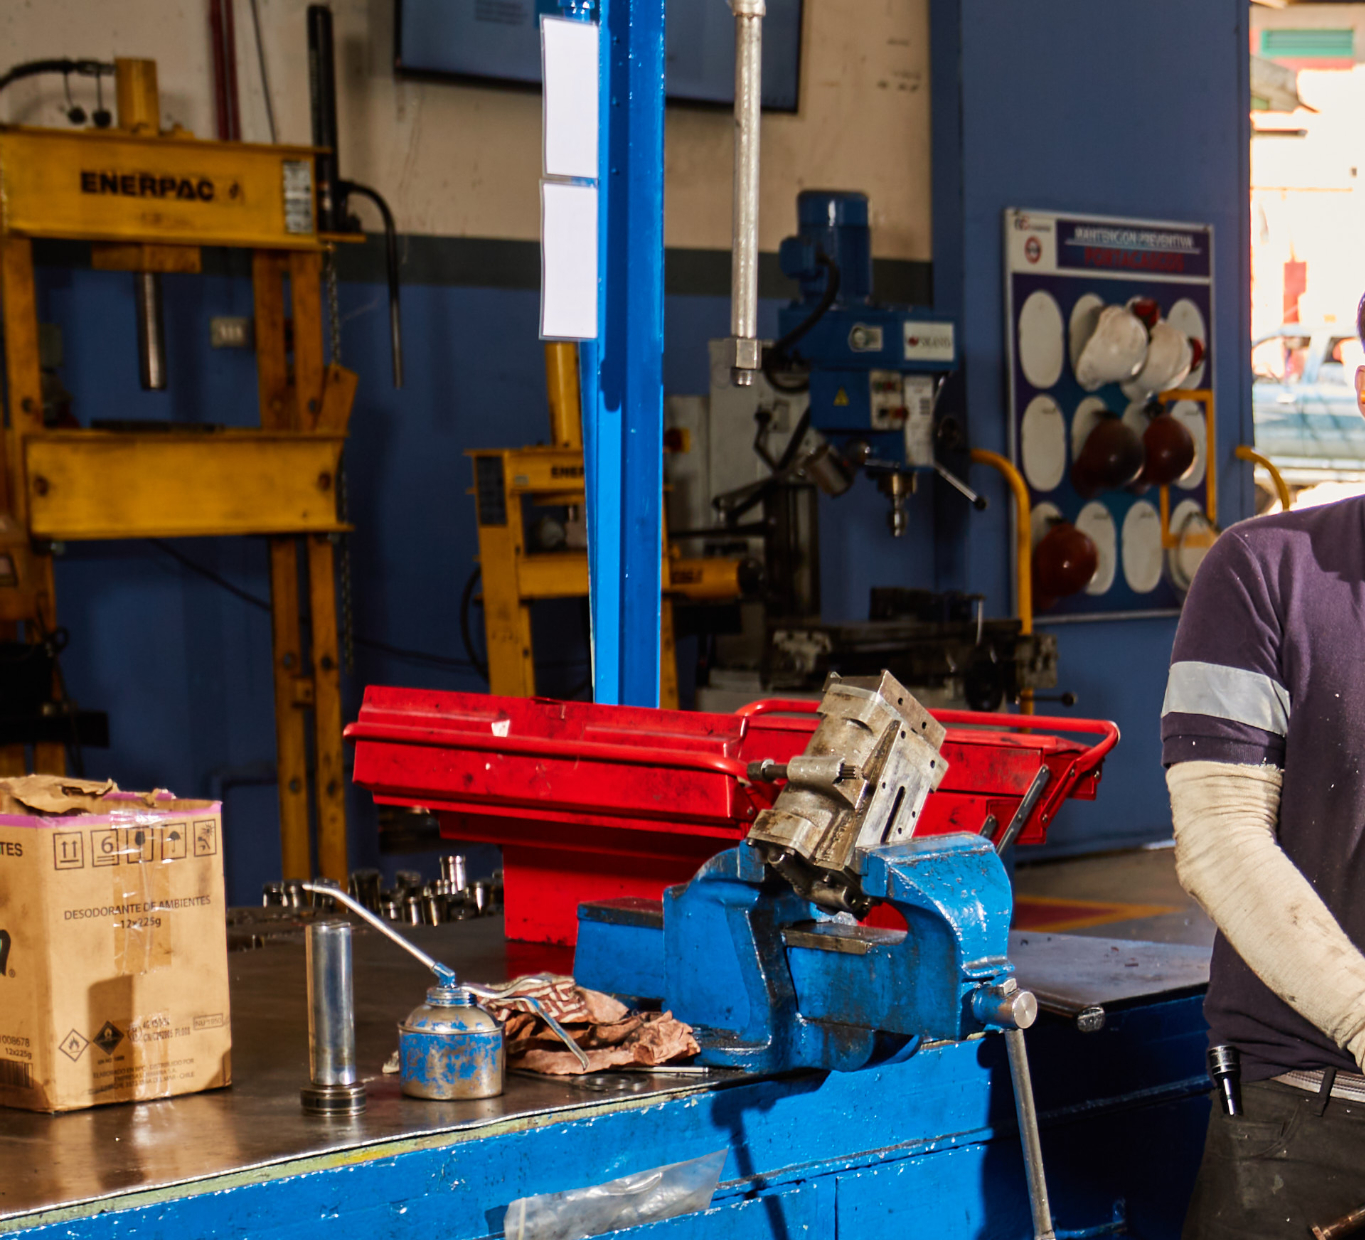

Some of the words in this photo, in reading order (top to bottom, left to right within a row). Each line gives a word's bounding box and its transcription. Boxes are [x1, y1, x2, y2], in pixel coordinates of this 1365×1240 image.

[81, 171, 214, 201] ENERPAC
[64, 903, 141, 920] DESODORANTE
[143, 901, 157, 912] DE
[159, 895, 211, 910] AMBIENTES
[5, 1047, 32, 1060] 12x225g
